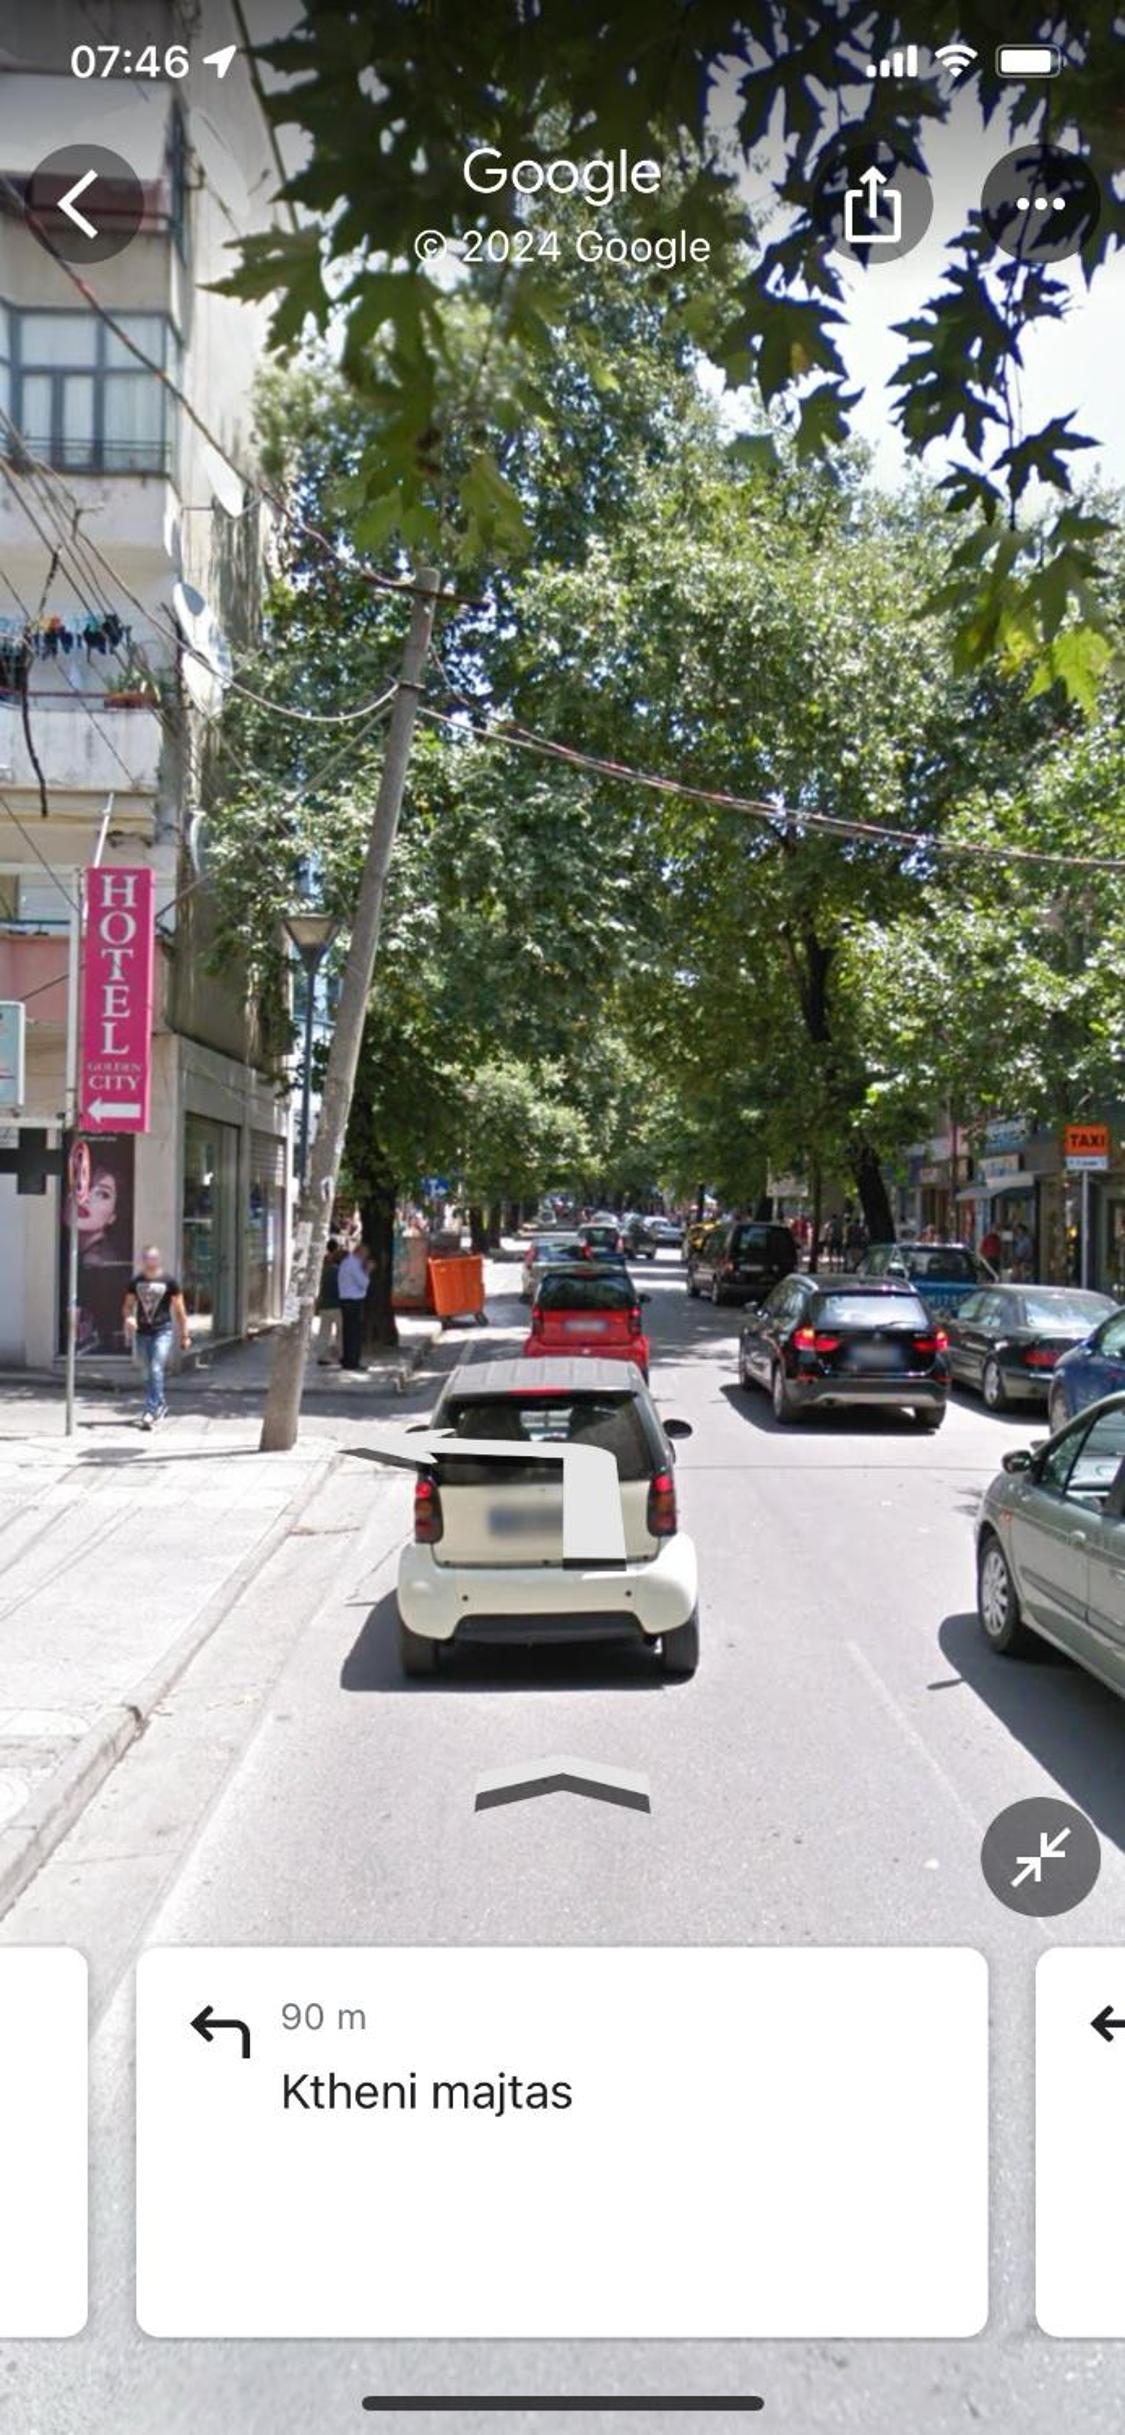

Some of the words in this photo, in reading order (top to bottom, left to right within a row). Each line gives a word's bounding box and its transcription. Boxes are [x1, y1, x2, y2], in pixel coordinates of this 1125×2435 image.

[101, 874, 137, 1055] HOTEL
[88, 1075, 140, 1090] CITY
[1069, 1133, 1105, 1148] TAXI
